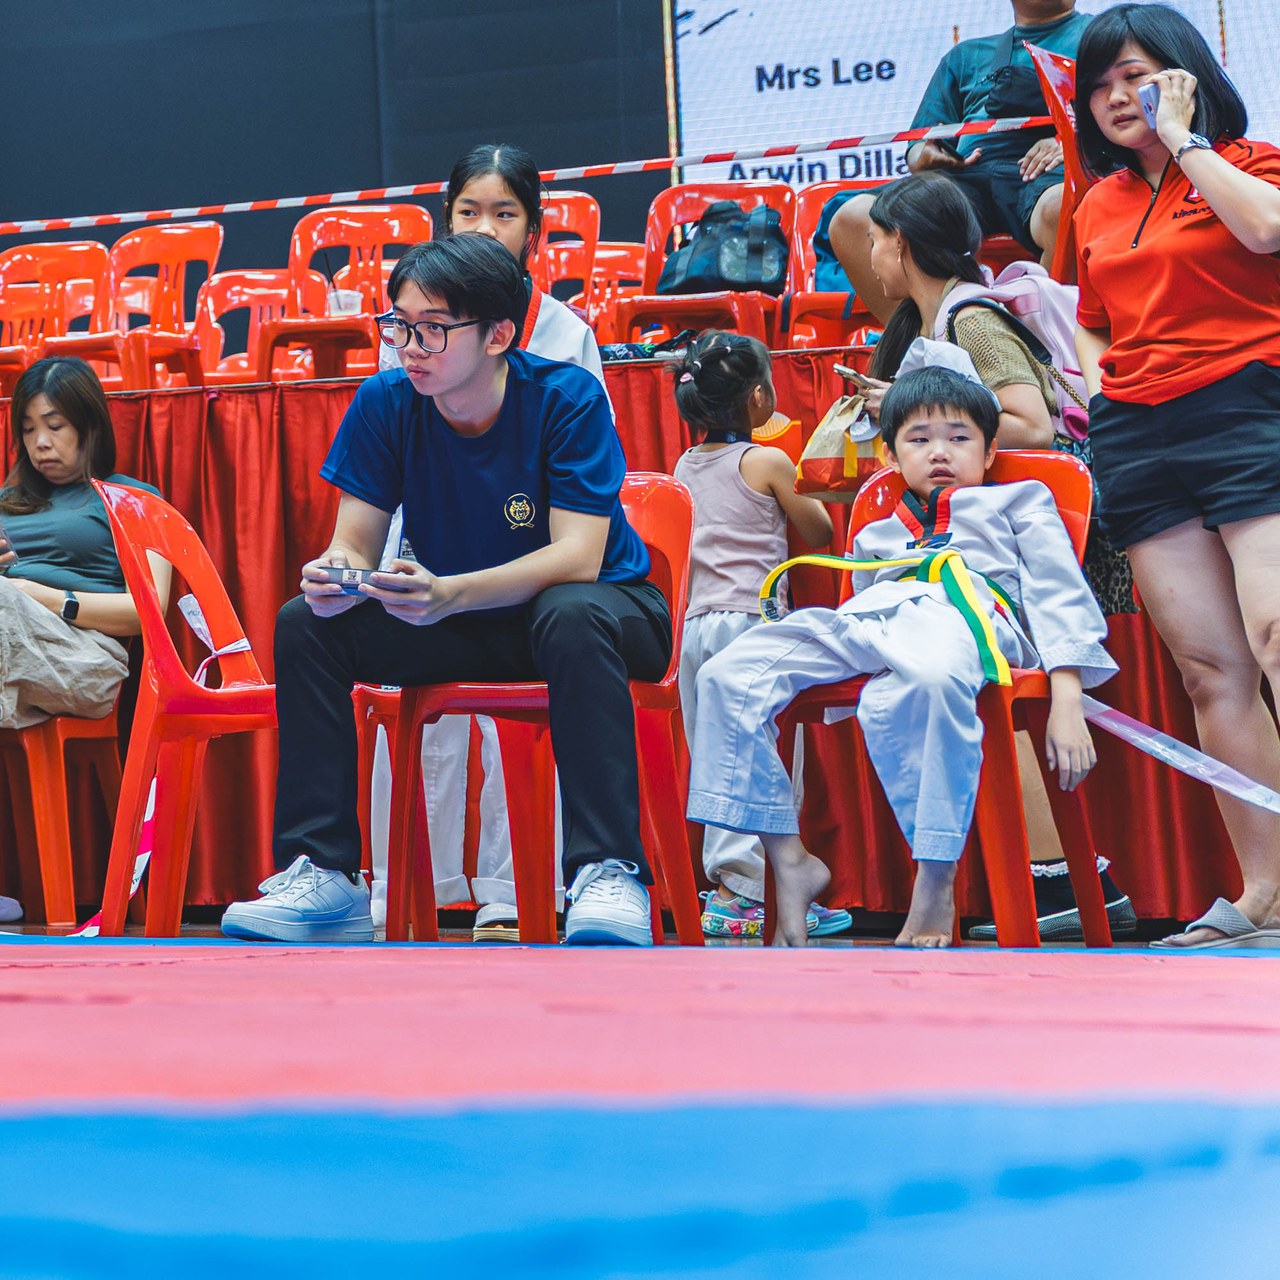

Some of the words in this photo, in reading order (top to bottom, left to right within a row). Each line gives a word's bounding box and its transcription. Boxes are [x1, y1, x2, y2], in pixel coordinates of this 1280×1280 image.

[755, 63, 821, 92] Mrs
[832, 58, 897, 86] Lee
[728, 157, 828, 184] Arwin
